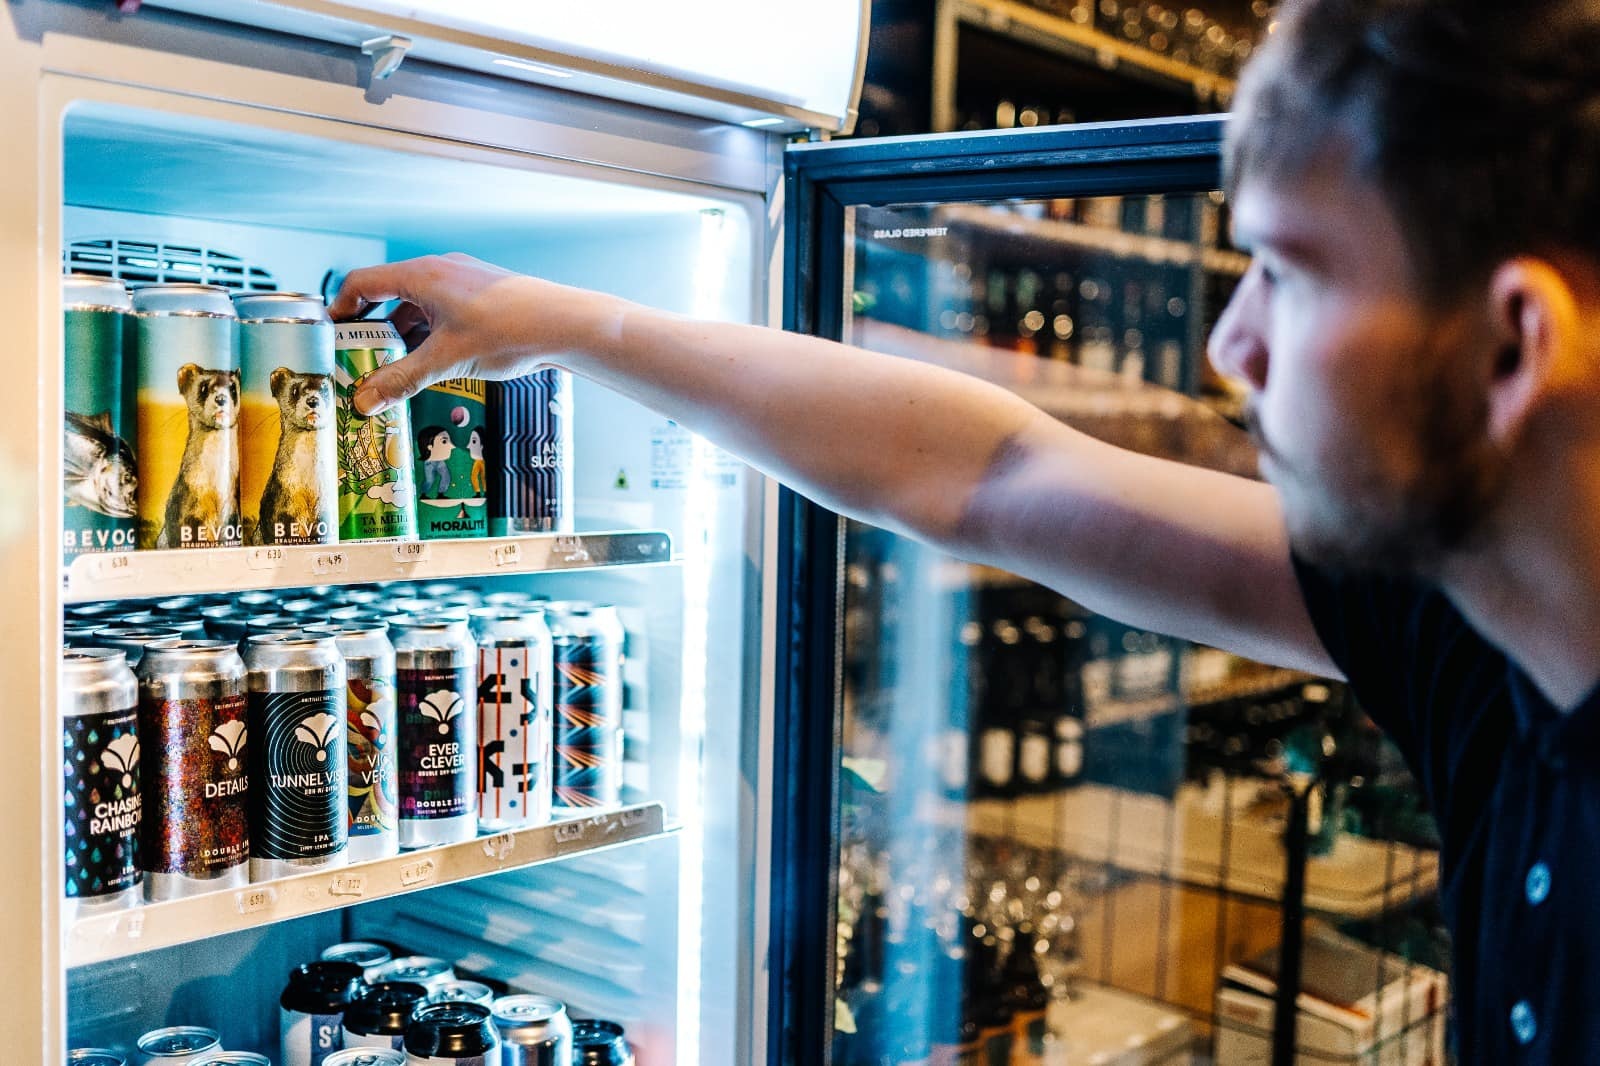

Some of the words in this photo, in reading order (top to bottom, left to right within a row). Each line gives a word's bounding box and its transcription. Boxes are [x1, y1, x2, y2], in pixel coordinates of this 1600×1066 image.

[428, 742, 460, 757] EVER
[420, 754, 465, 770] CLEVER
[205, 775, 249, 799] DETAILS
[270, 772, 324, 788] TUNNEL
[416, 800, 452, 808] DOUBLE
[314, 834, 329, 843] IPA
